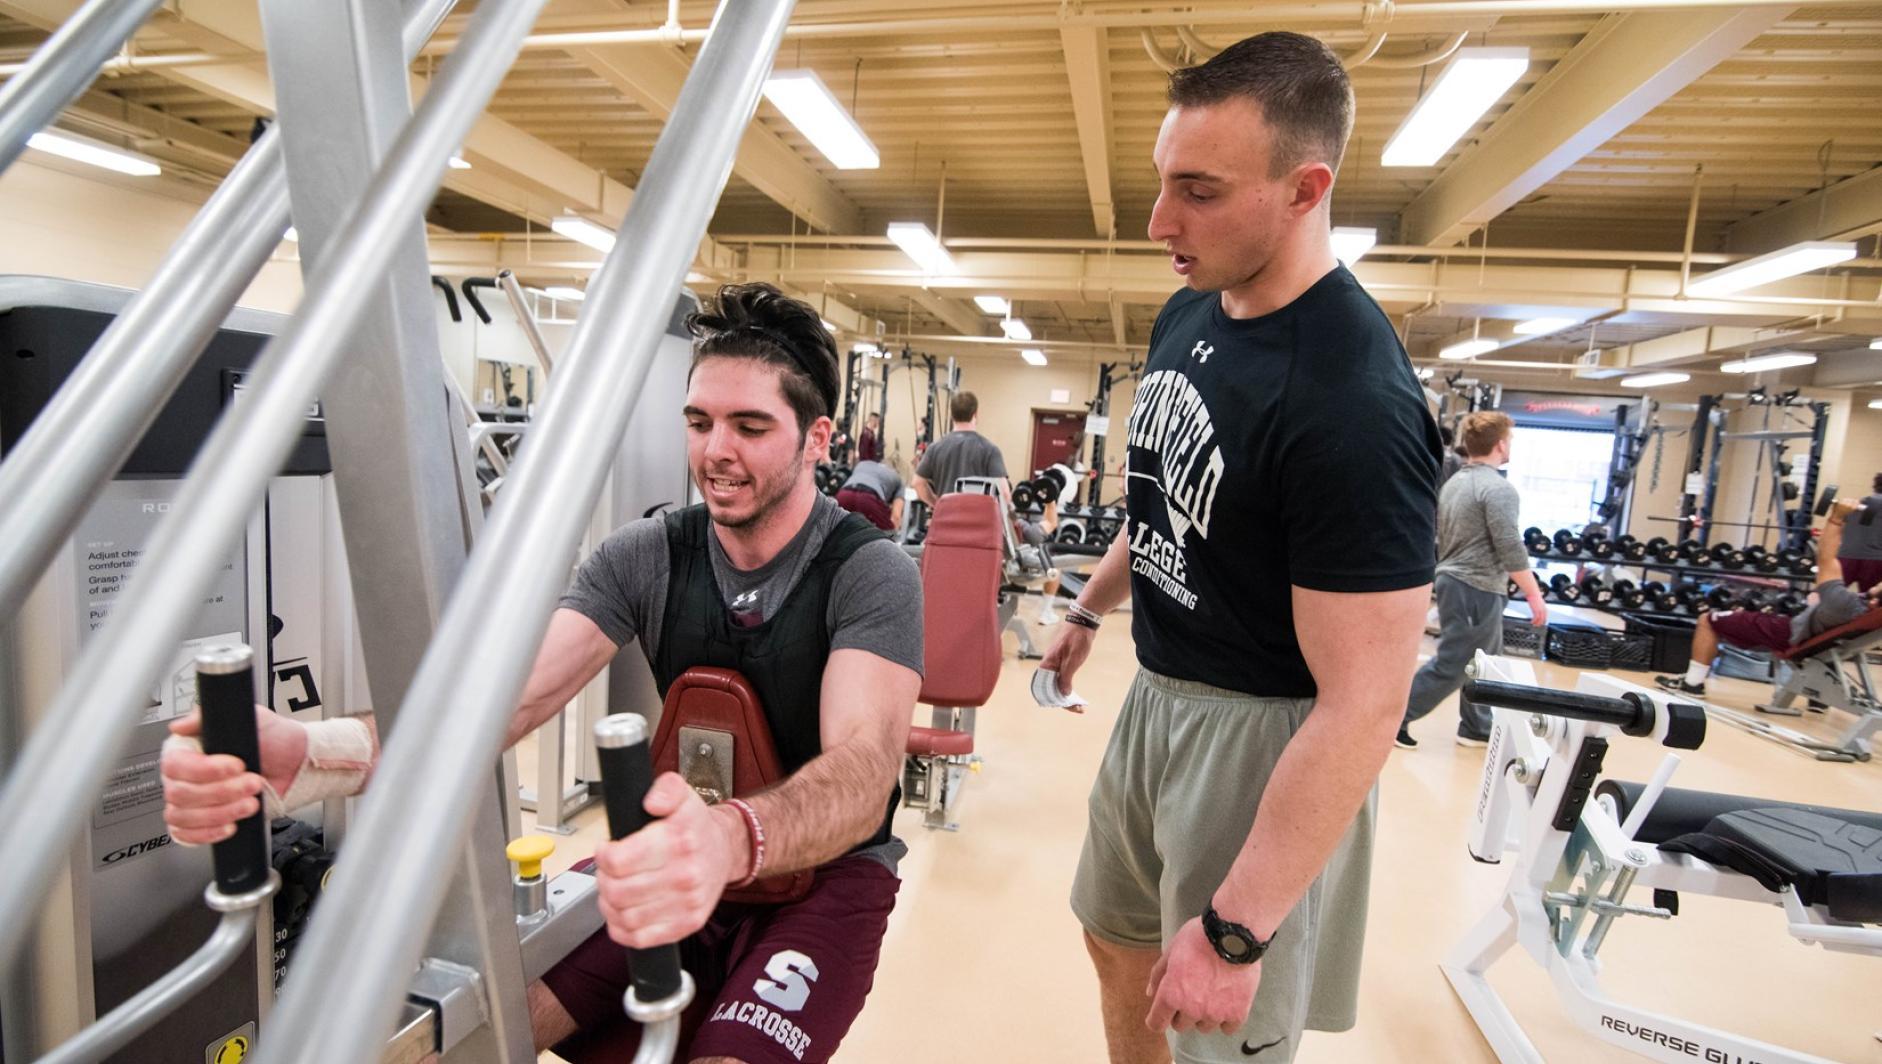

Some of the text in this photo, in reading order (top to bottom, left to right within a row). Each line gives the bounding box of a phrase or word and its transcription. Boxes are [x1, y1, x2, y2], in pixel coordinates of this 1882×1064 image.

[142, 502, 171, 514] RO
[88, 551, 119, 561] Adjust
[1126, 513, 1187, 584] LEGE
[88, 575, 119, 585] Grasp
[88, 583, 120, 595] of and
[1131, 556, 1199, 611] CONDITIONING
[275, 928, 288, 943] 30
[752, 949, 820, 1011] S
[709, 1000, 812, 1061] LACROSSE
[1600, 1015, 1700, 1057] REVERSE
